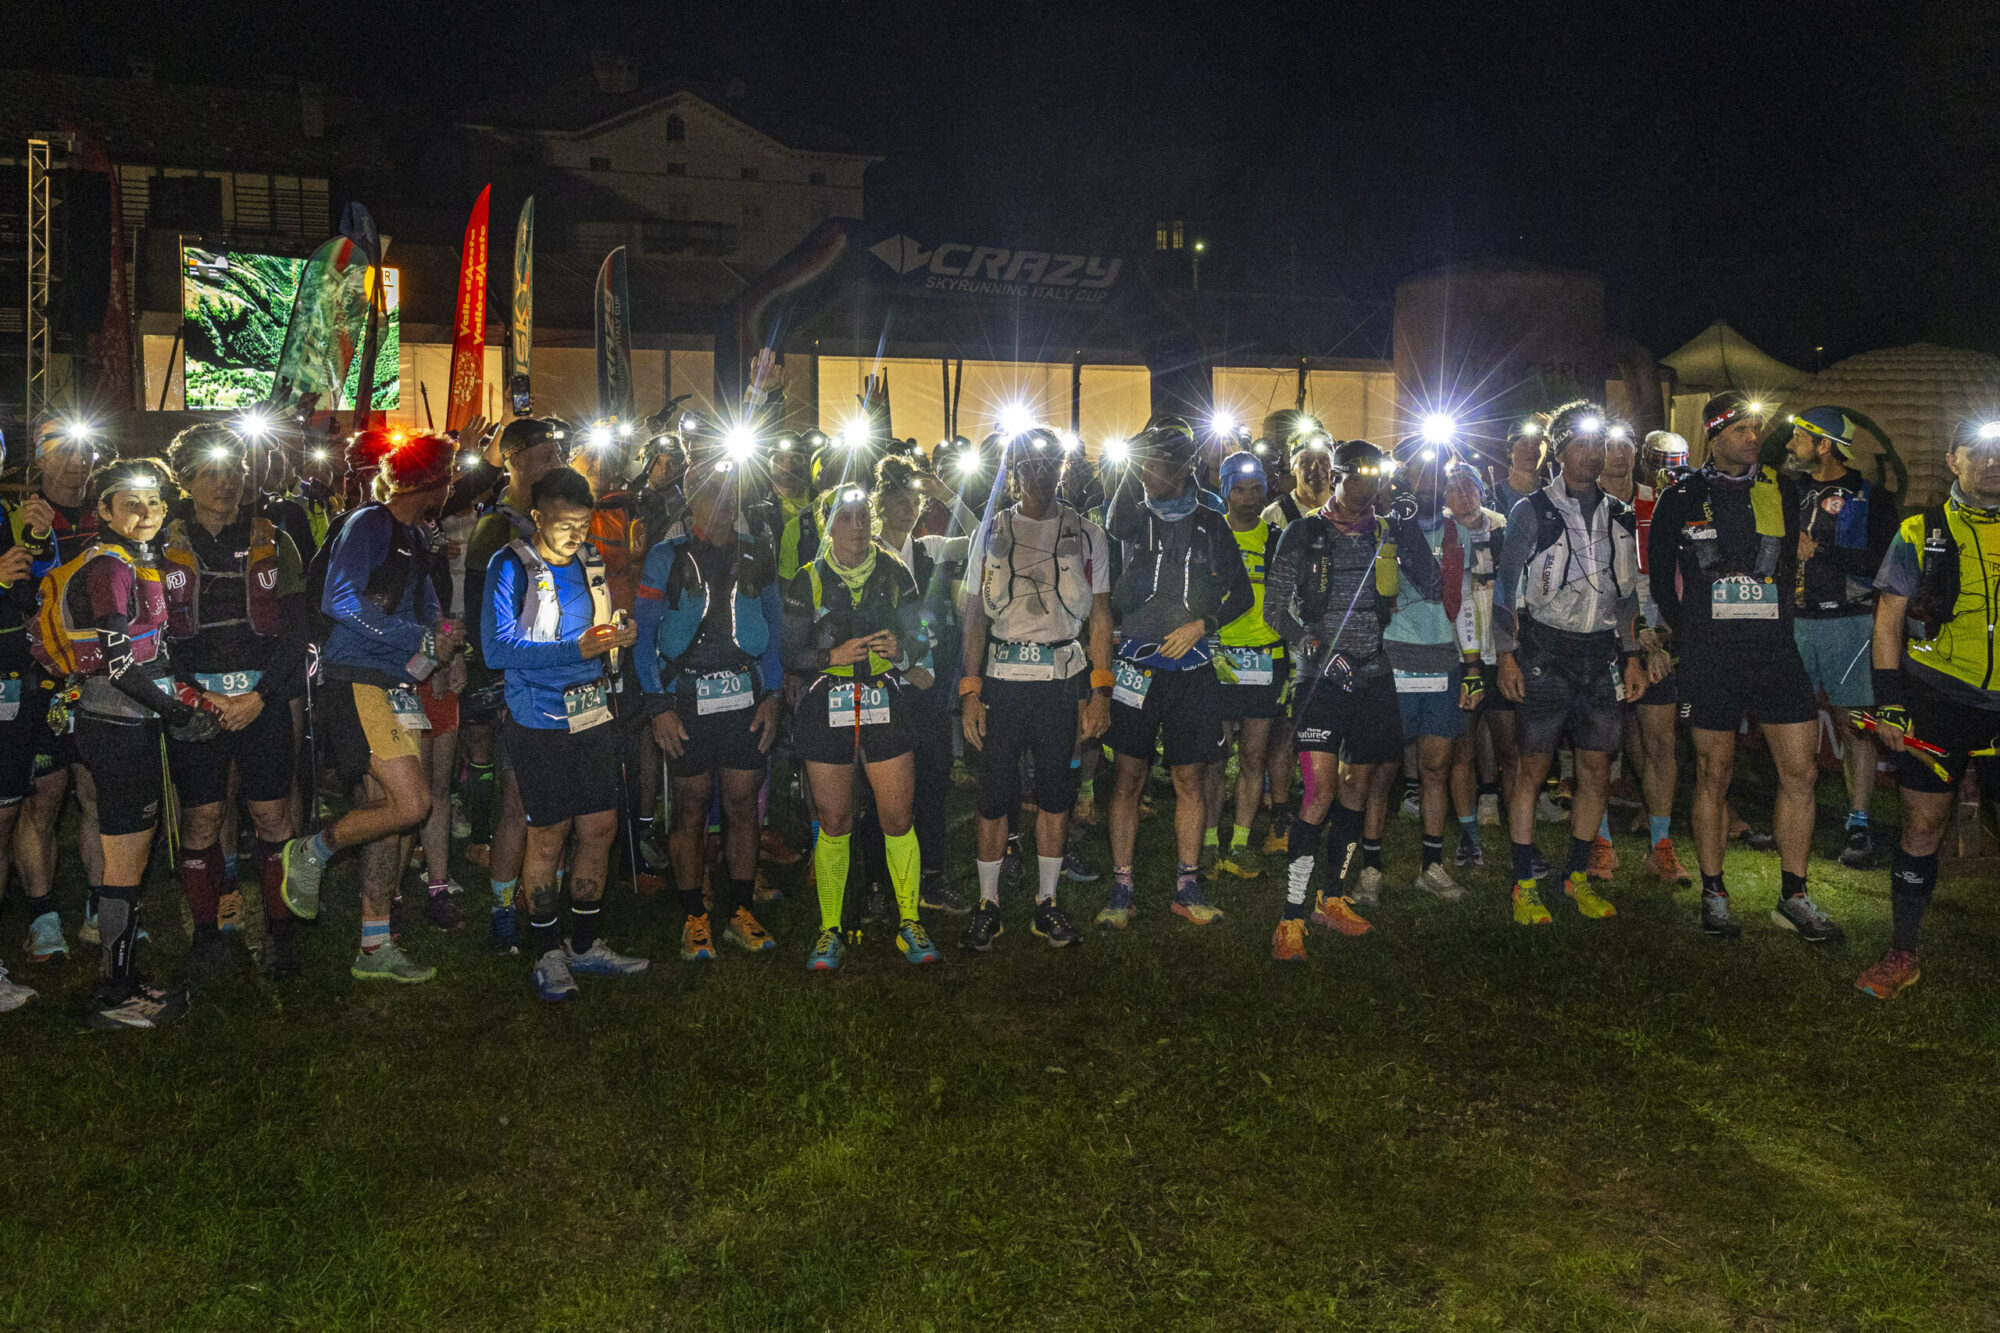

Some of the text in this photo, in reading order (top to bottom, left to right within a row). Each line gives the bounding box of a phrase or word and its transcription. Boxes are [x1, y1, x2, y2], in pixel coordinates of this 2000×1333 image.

[931, 242, 1123, 288] CRAZY
[925, 275, 1109, 303] SKYRUNNING ITALY CUP
[460, 286, 471, 337] Valle
[1542, 554, 1555, 596] SALOMON
[984, 569, 999, 611] SALOMON
[1739, 584, 1763, 601] 89
[1019, 646, 1041, 662] 88
[1242, 655, 1260, 669] 51
[222, 673, 249, 690] 93
[721, 676, 741, 694] 20
[1116, 668, 1144, 690] 138
[580, 688, 601, 712] 134
[848, 689, 881, 707] 140
